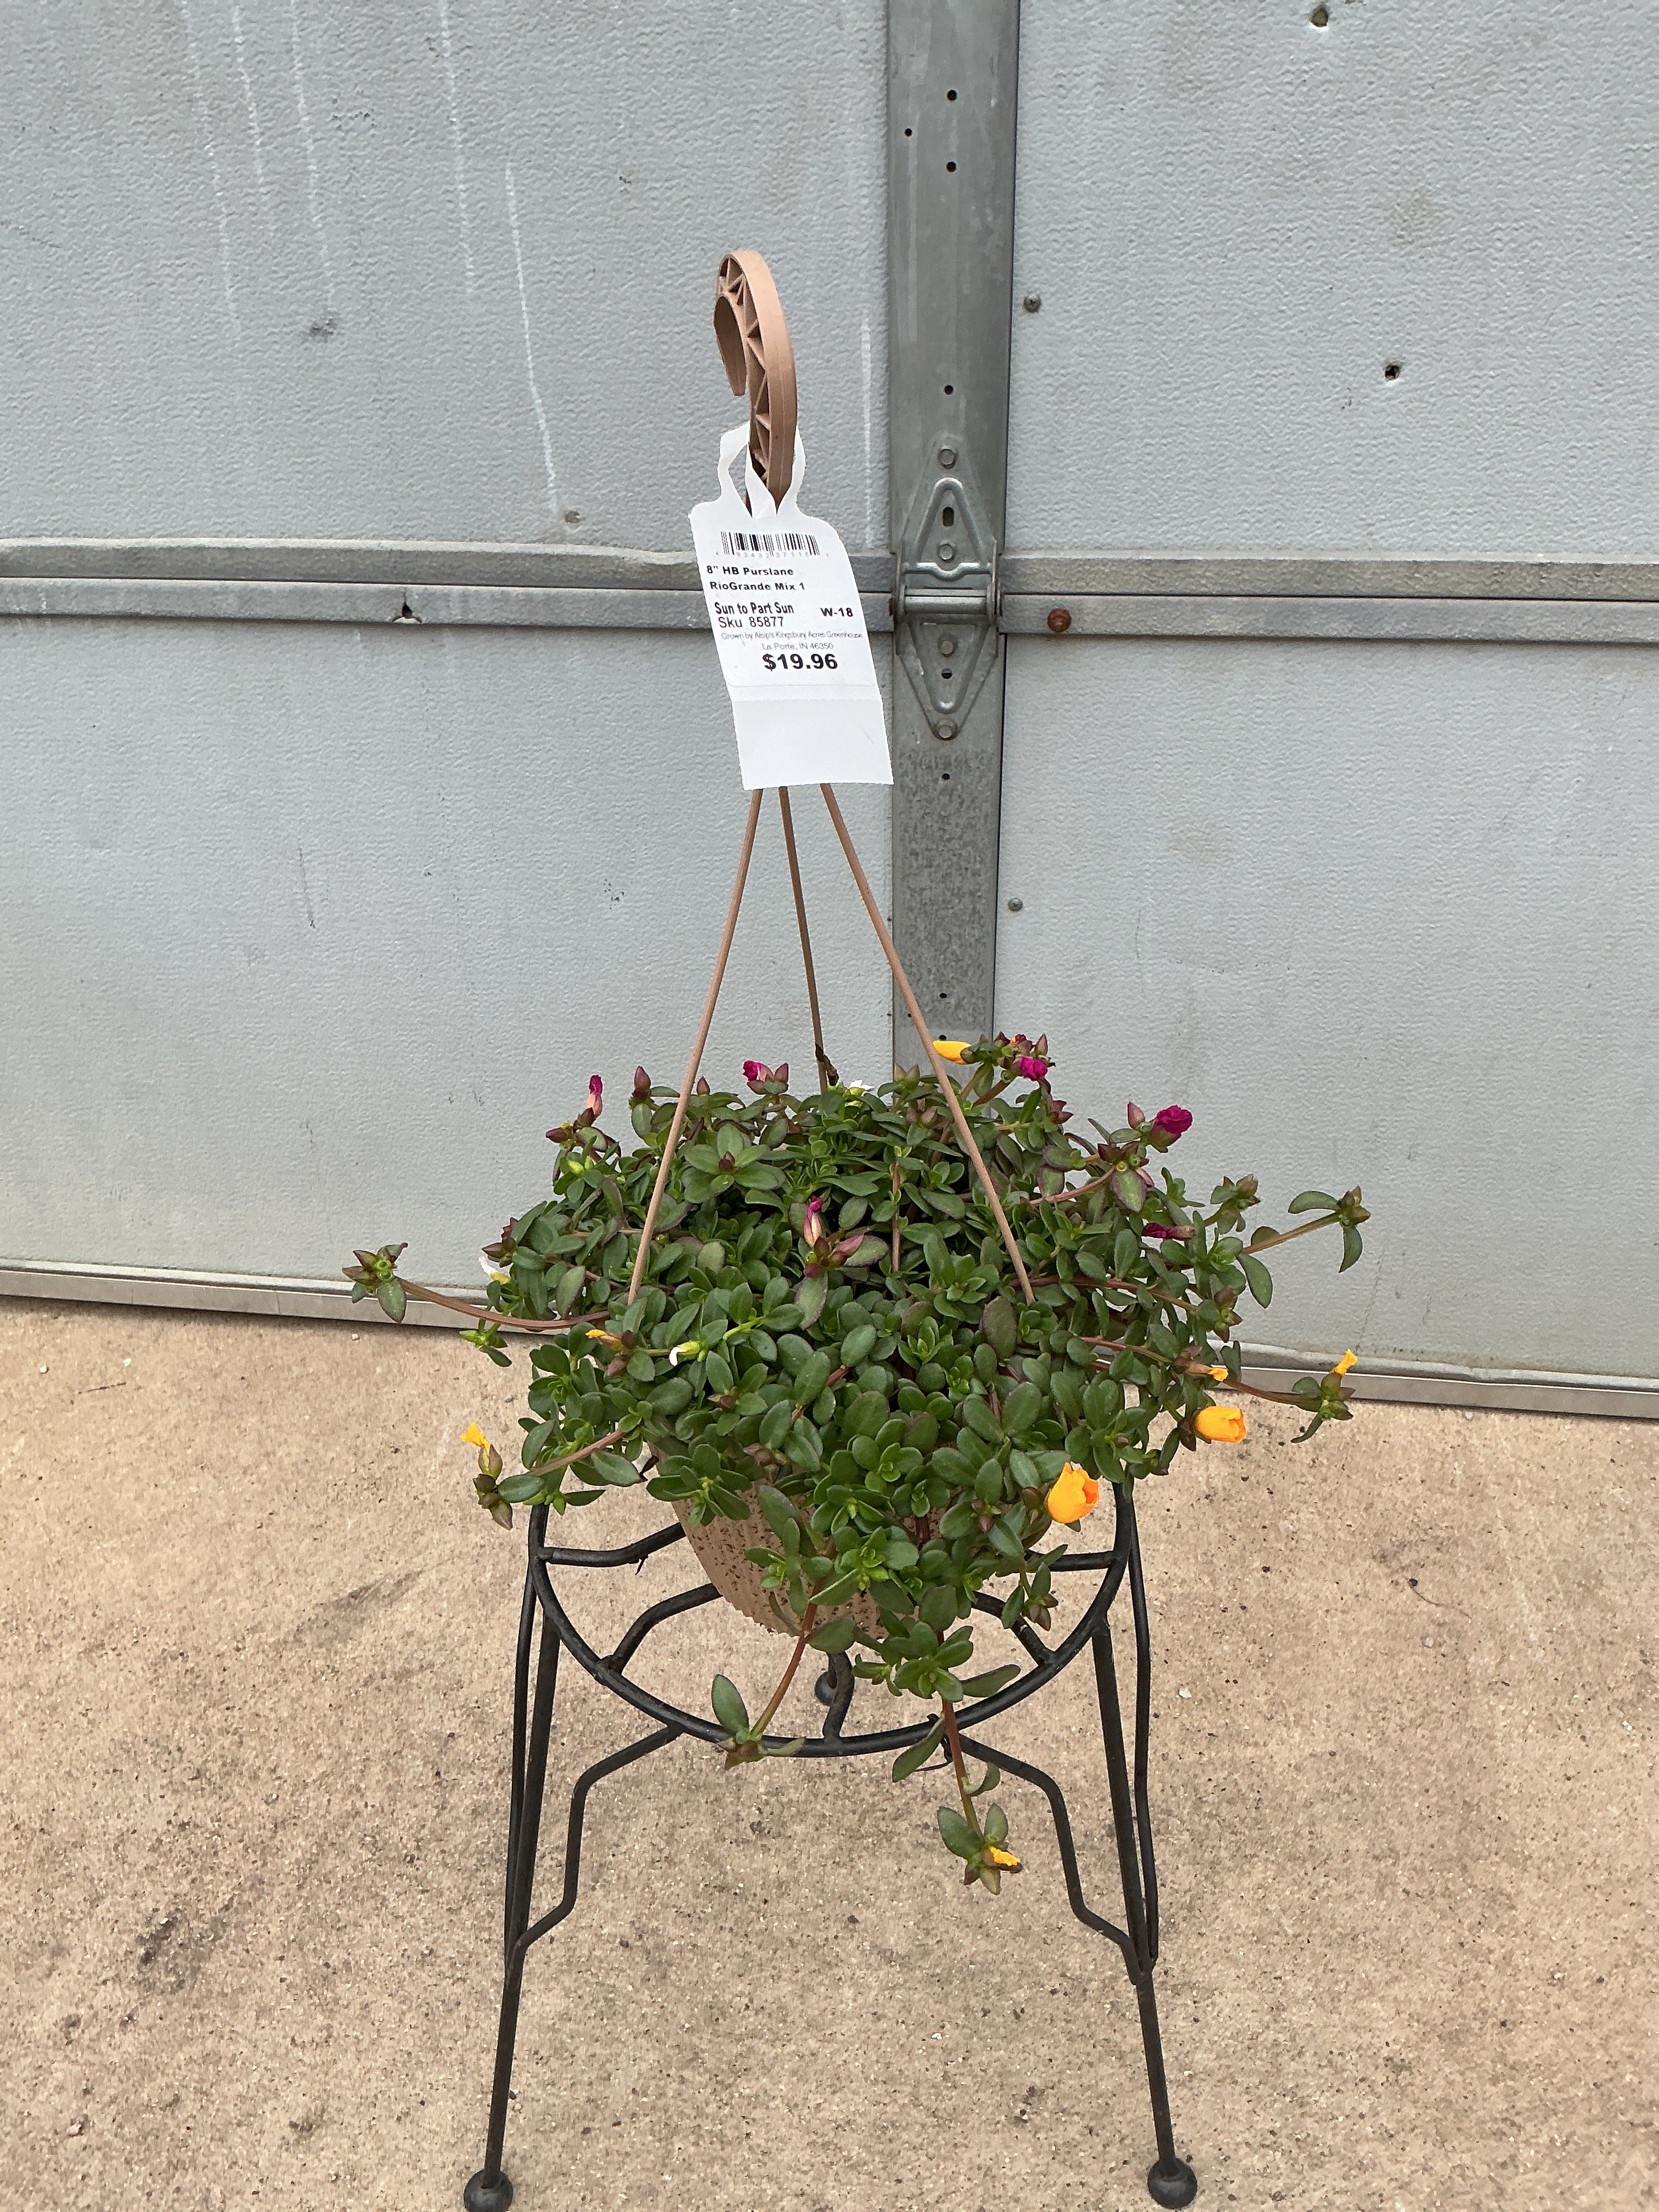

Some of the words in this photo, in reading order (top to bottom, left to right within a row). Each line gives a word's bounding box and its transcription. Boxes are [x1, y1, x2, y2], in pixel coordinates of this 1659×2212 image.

[722, 566, 740, 575] HB
[743, 567, 794, 575] Purslane
[709, 581, 771, 590] RioGrande
[775, 582, 796, 590] Mix
[799, 582, 805, 590] 1
[714, 602, 735, 614] Sun
[737, 603, 748, 614] to
[750, 602, 773, 614] Part
[774, 601, 794, 614] Sun
[820, 607, 854, 617] W-18
[718, 616, 743, 628] Sku
[749, 616, 784, 628] 85877
[721, 632, 744, 640] Grown
[744, 631, 753, 641] by
[775, 631, 806, 640] Kingsbury
[826, 630, 862, 639] Greenhouse
[761, 642, 772, 651] La
[774, 642, 798, 651] Porte,
[762, 653, 838, 672] $19.96
